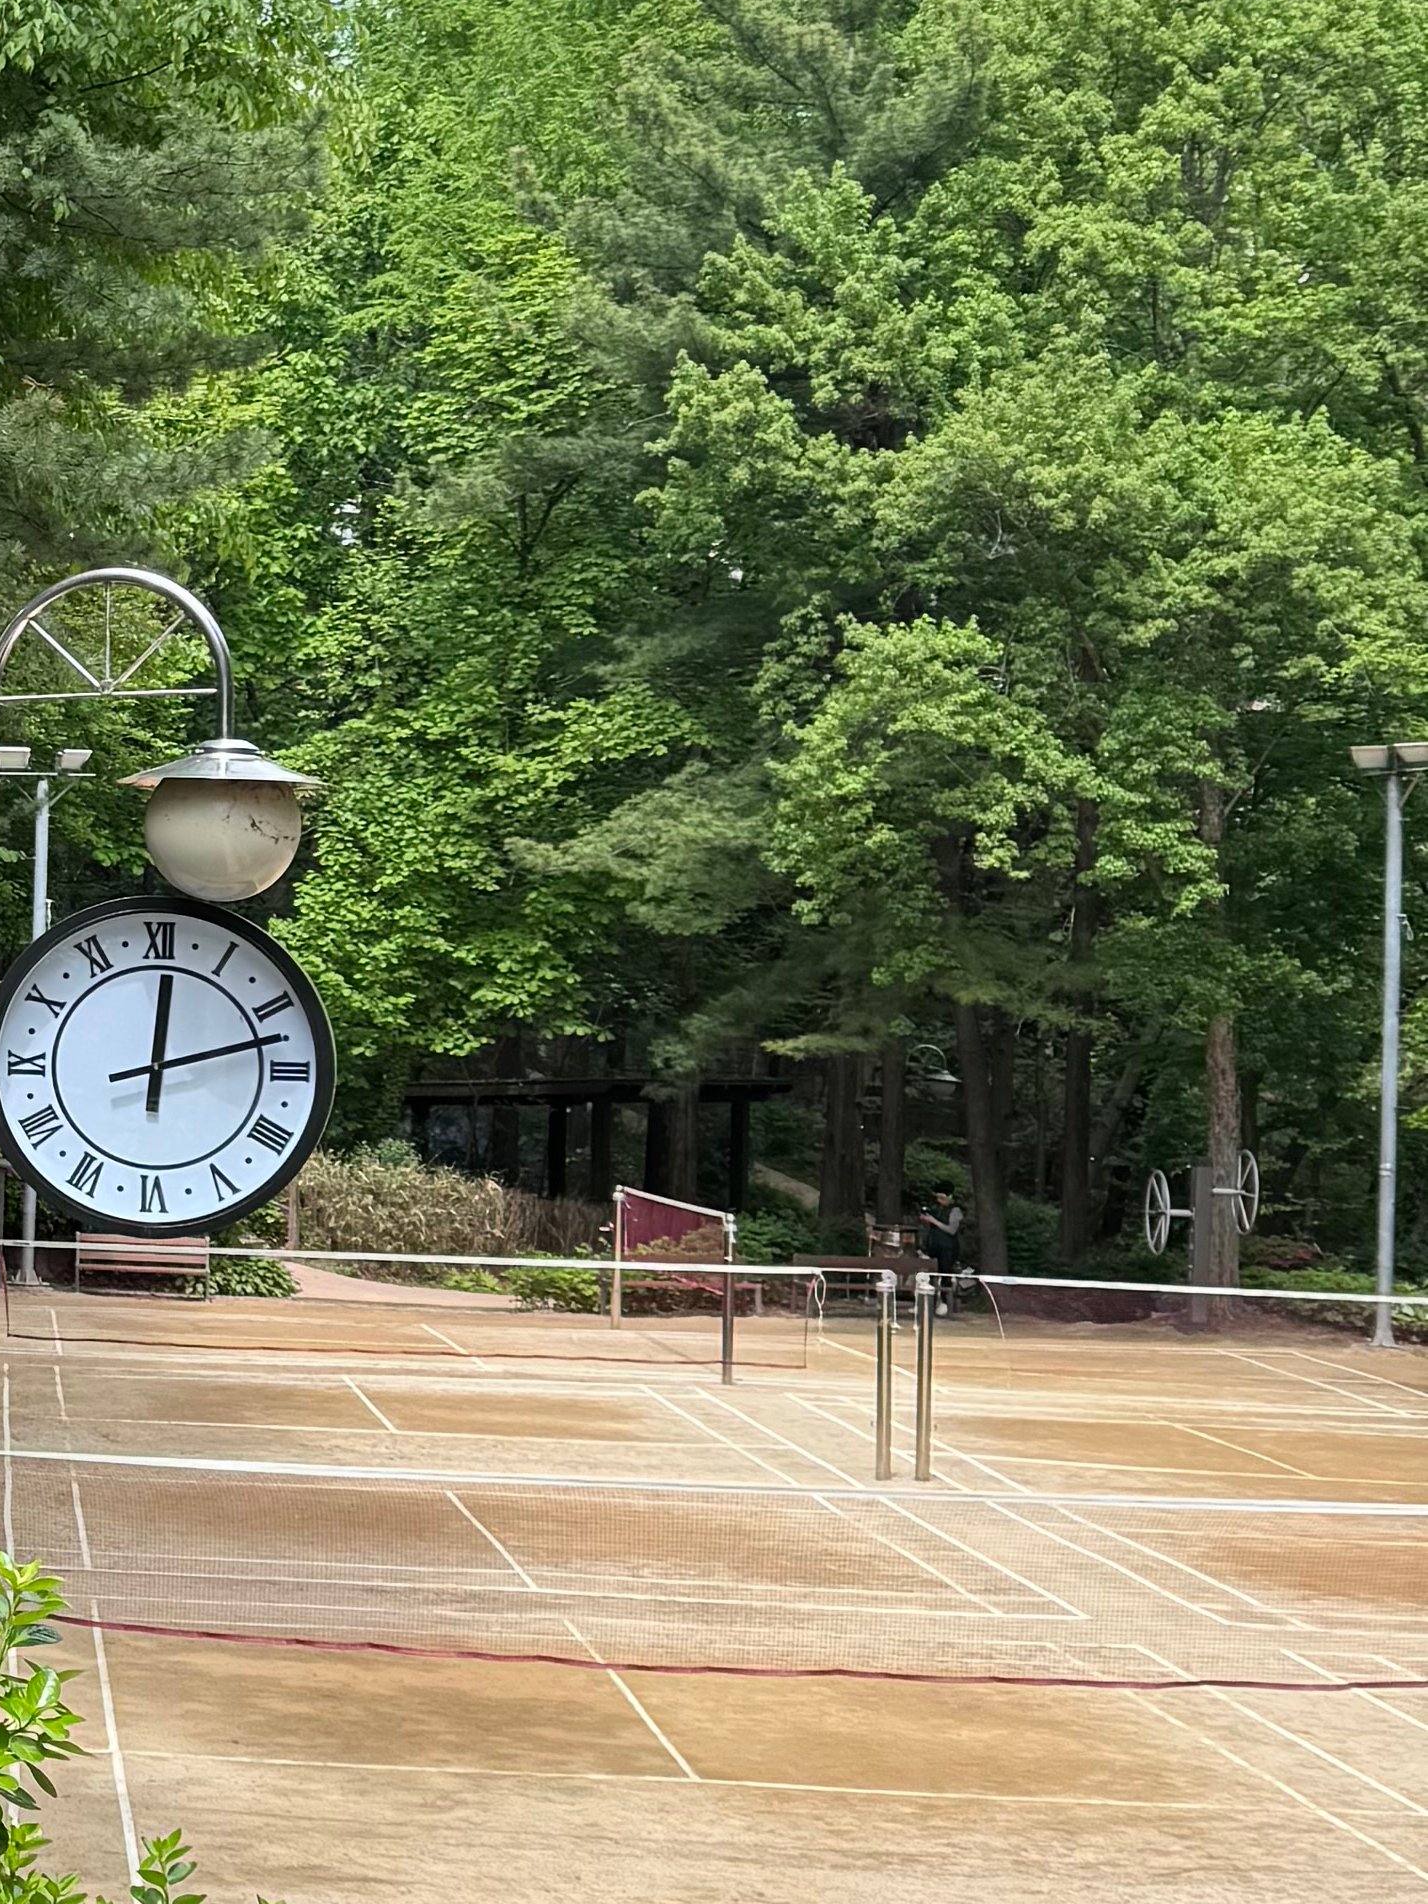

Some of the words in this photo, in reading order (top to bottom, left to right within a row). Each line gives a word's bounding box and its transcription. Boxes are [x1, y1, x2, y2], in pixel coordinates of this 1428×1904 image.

[73, 934, 114, 978] XI
[142, 920, 176, 960] XII
[211, 940, 240, 977] I
[24, 983, 67, 1019] X
[251, 990, 295, 1024] II
[8, 1049, 46, 1077] IX
[270, 1059, 311, 1083] III
[18, 1103, 64, 1150] VIII
[246, 1113, 295, 1157] IIII
[66, 1151, 104, 1198] VII
[210, 1163, 241, 1202] V
[140, 1175, 168, 1213] VI
